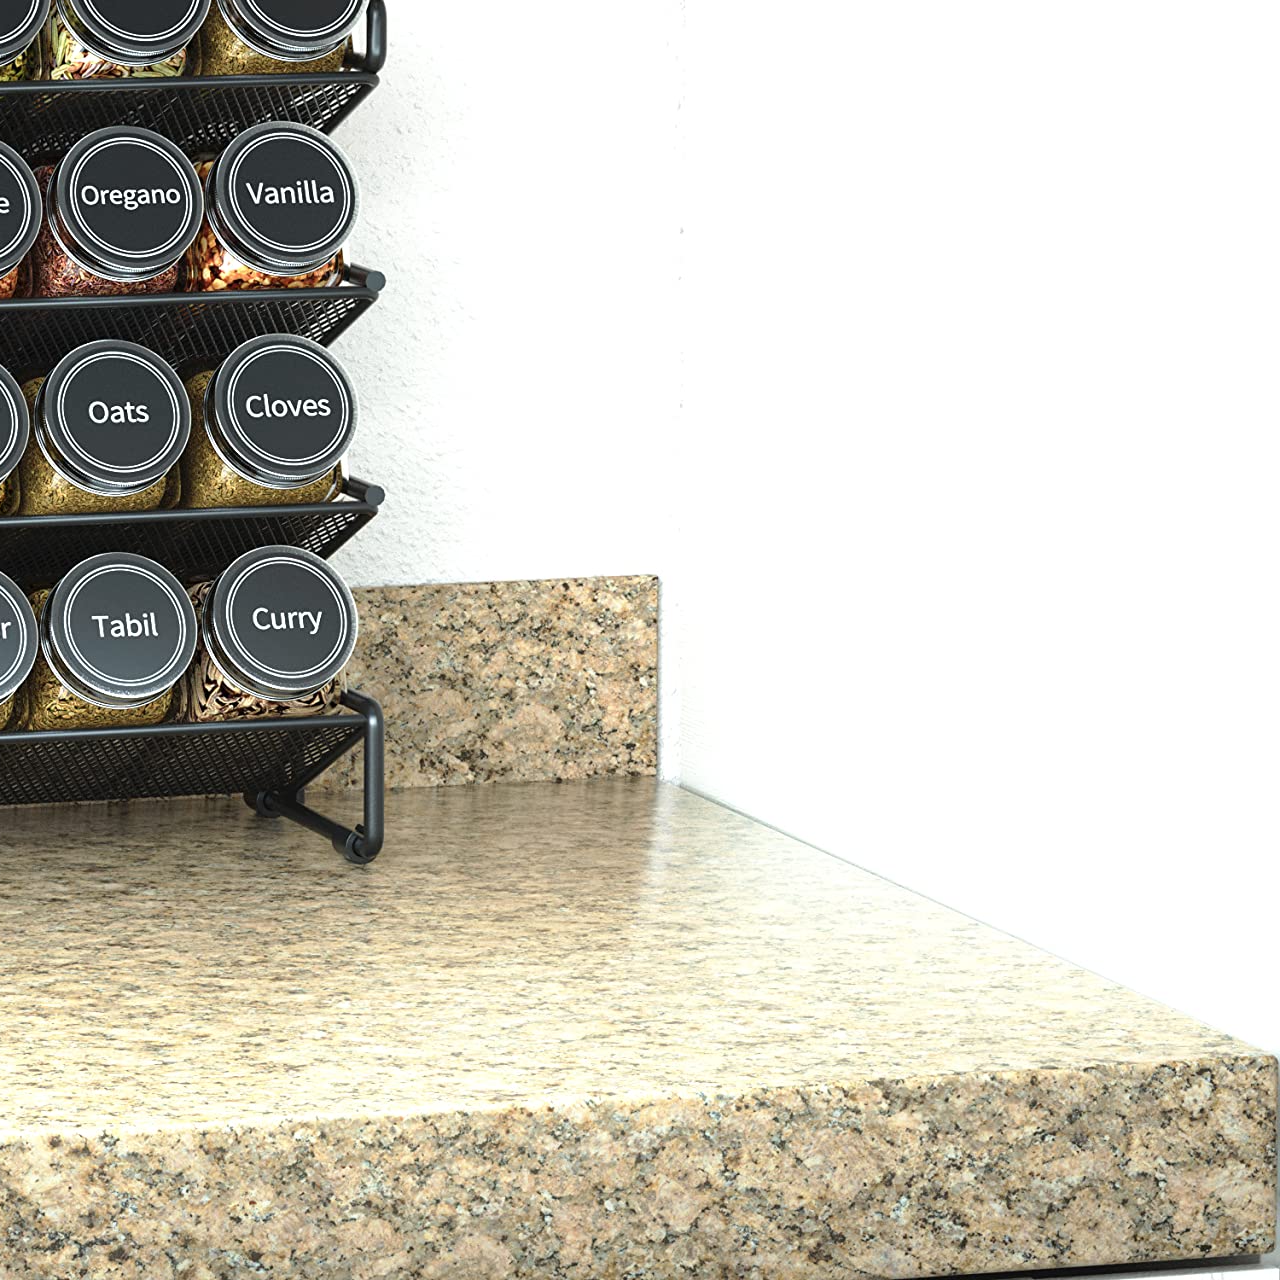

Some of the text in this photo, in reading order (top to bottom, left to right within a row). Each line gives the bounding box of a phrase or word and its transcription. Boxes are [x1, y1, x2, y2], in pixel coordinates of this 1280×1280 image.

[80, 185, 181, 211] Oregano
[245, 179, 335, 205] Vanilla
[88, 400, 150, 424] Oats
[245, 393, 332, 418] Cloves
[91, 611, 159, 638] Tabil
[252, 606, 323, 635] Curry
